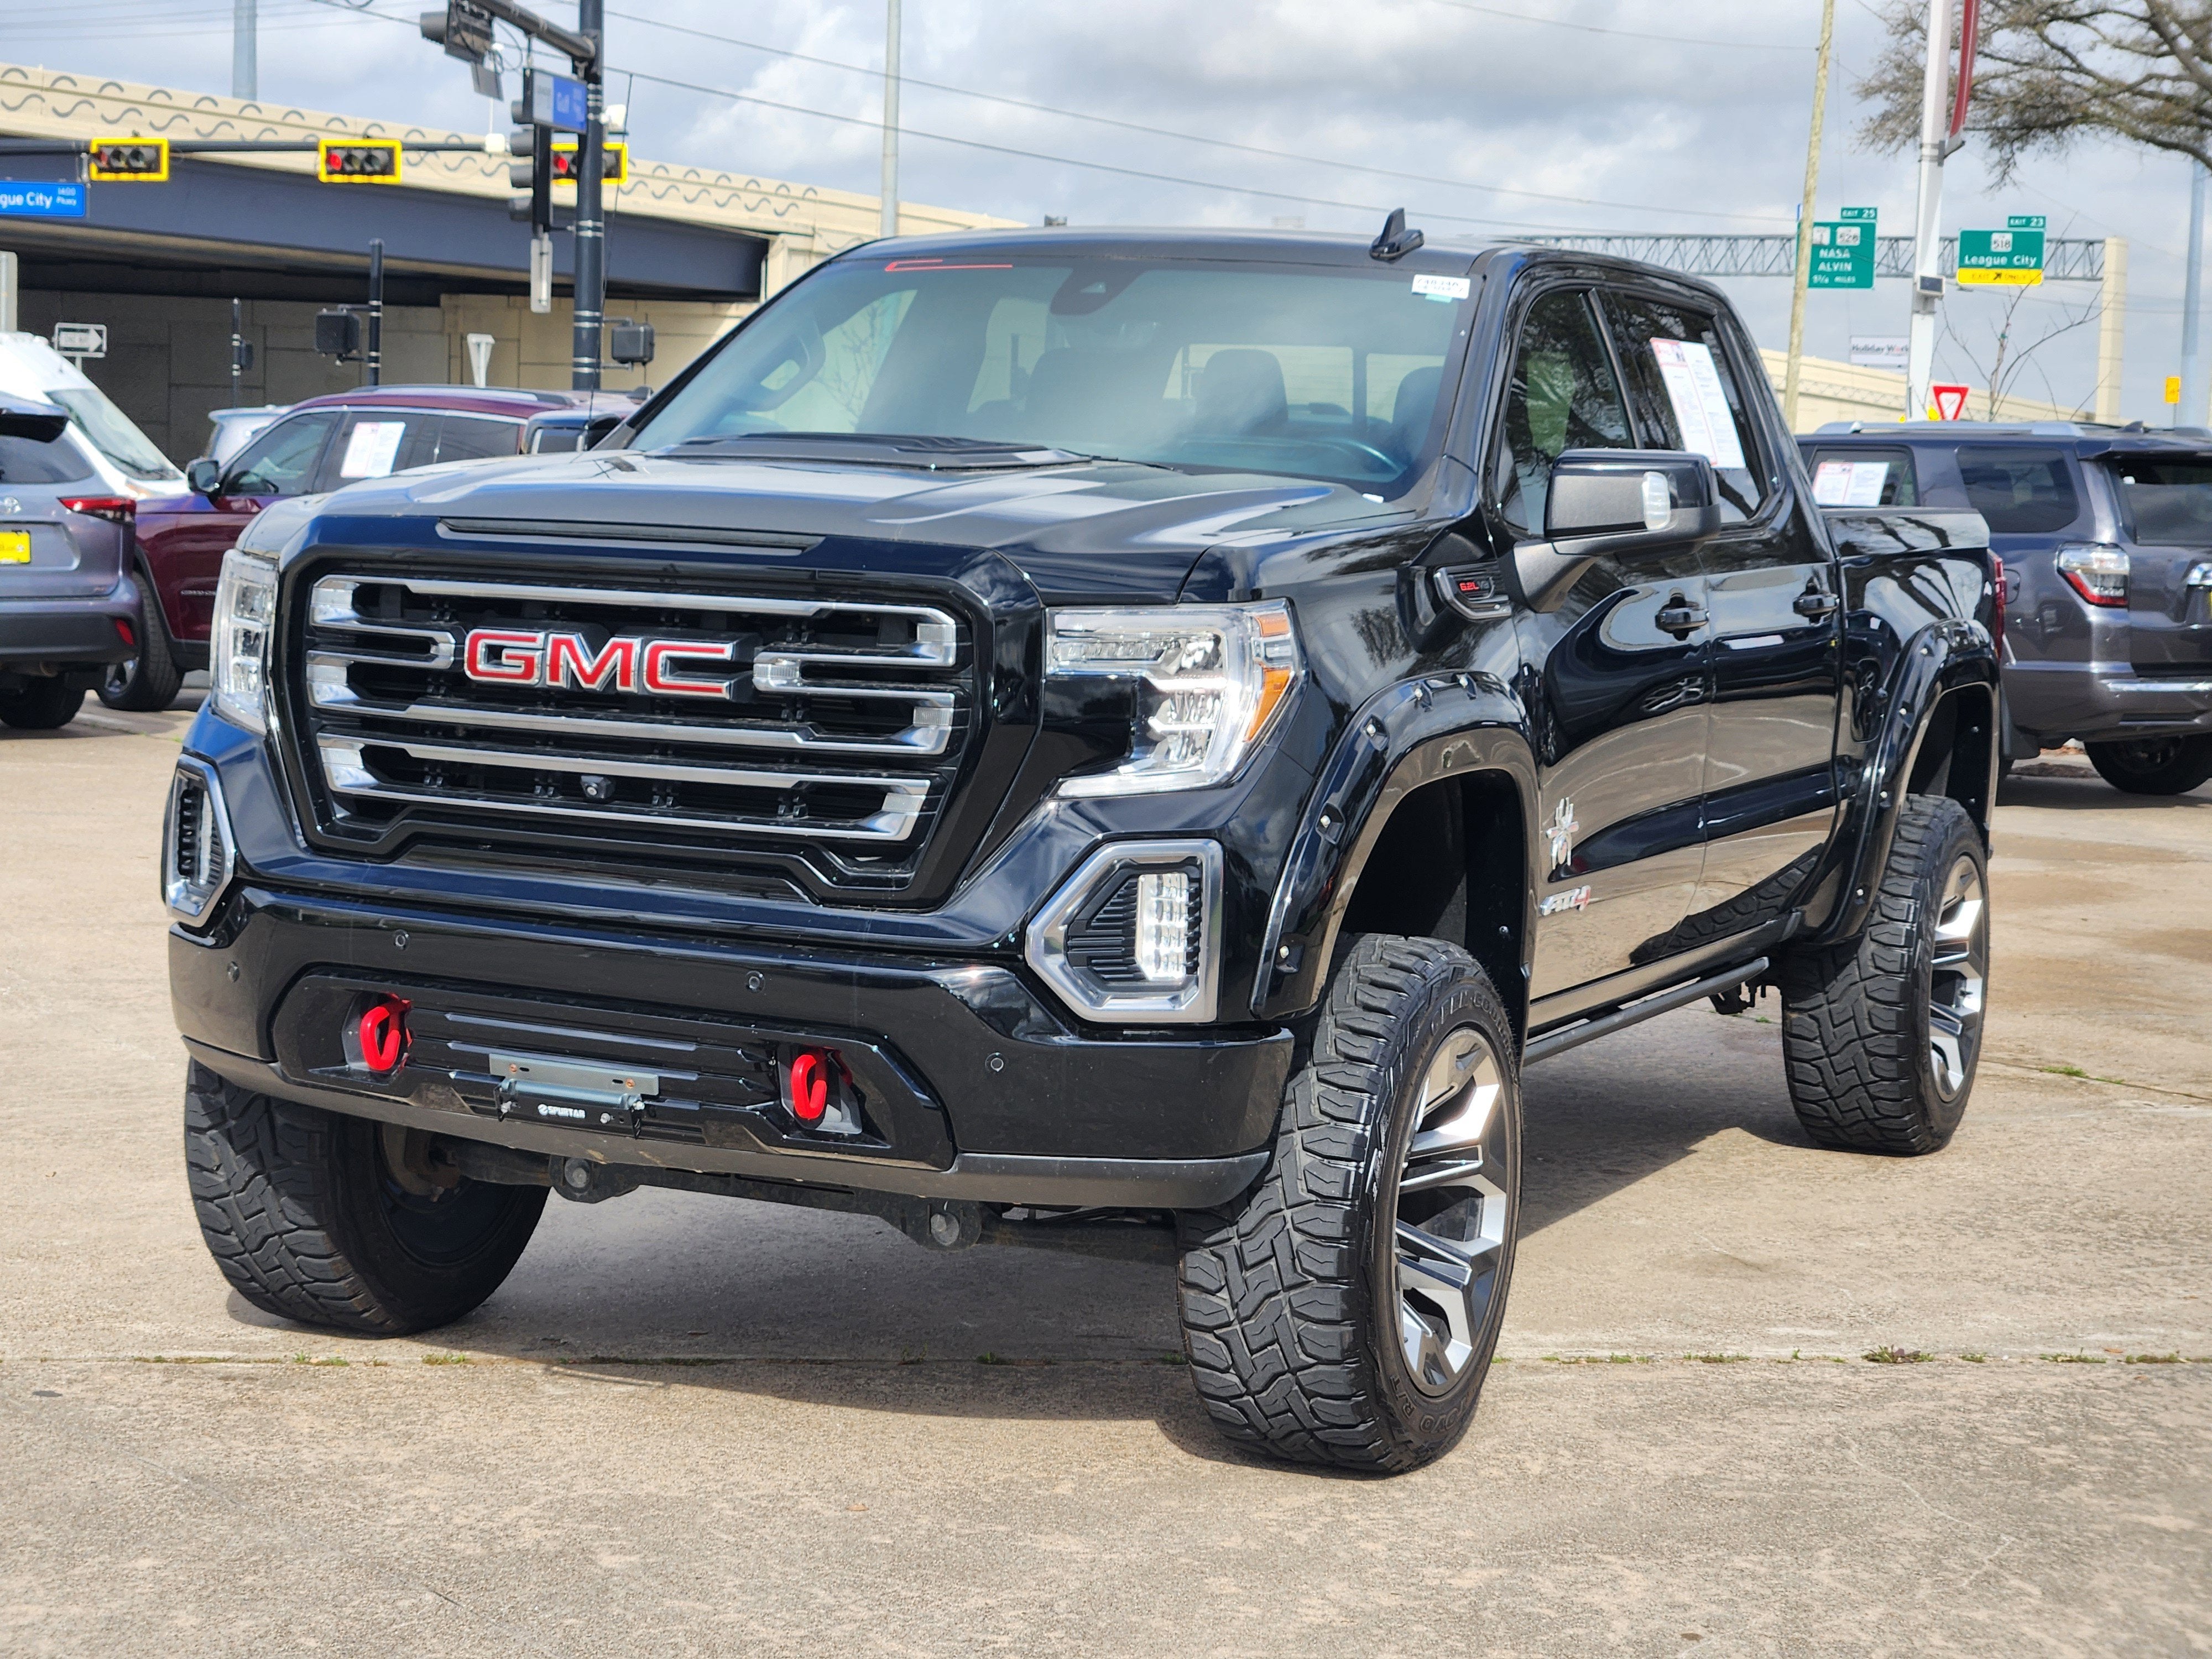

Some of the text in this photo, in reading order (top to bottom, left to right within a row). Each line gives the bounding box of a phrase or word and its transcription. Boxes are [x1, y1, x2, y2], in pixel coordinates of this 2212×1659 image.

[26, 191, 53, 209] City
[2030, 217, 2044, 227] 23
[1993, 239, 2011, 249] 518
[1819, 248, 1851, 259] NASA
[1817, 261, 1853, 272] ALVIN
[1964, 254, 2037, 268] League City
[465, 628, 734, 701] GMC
